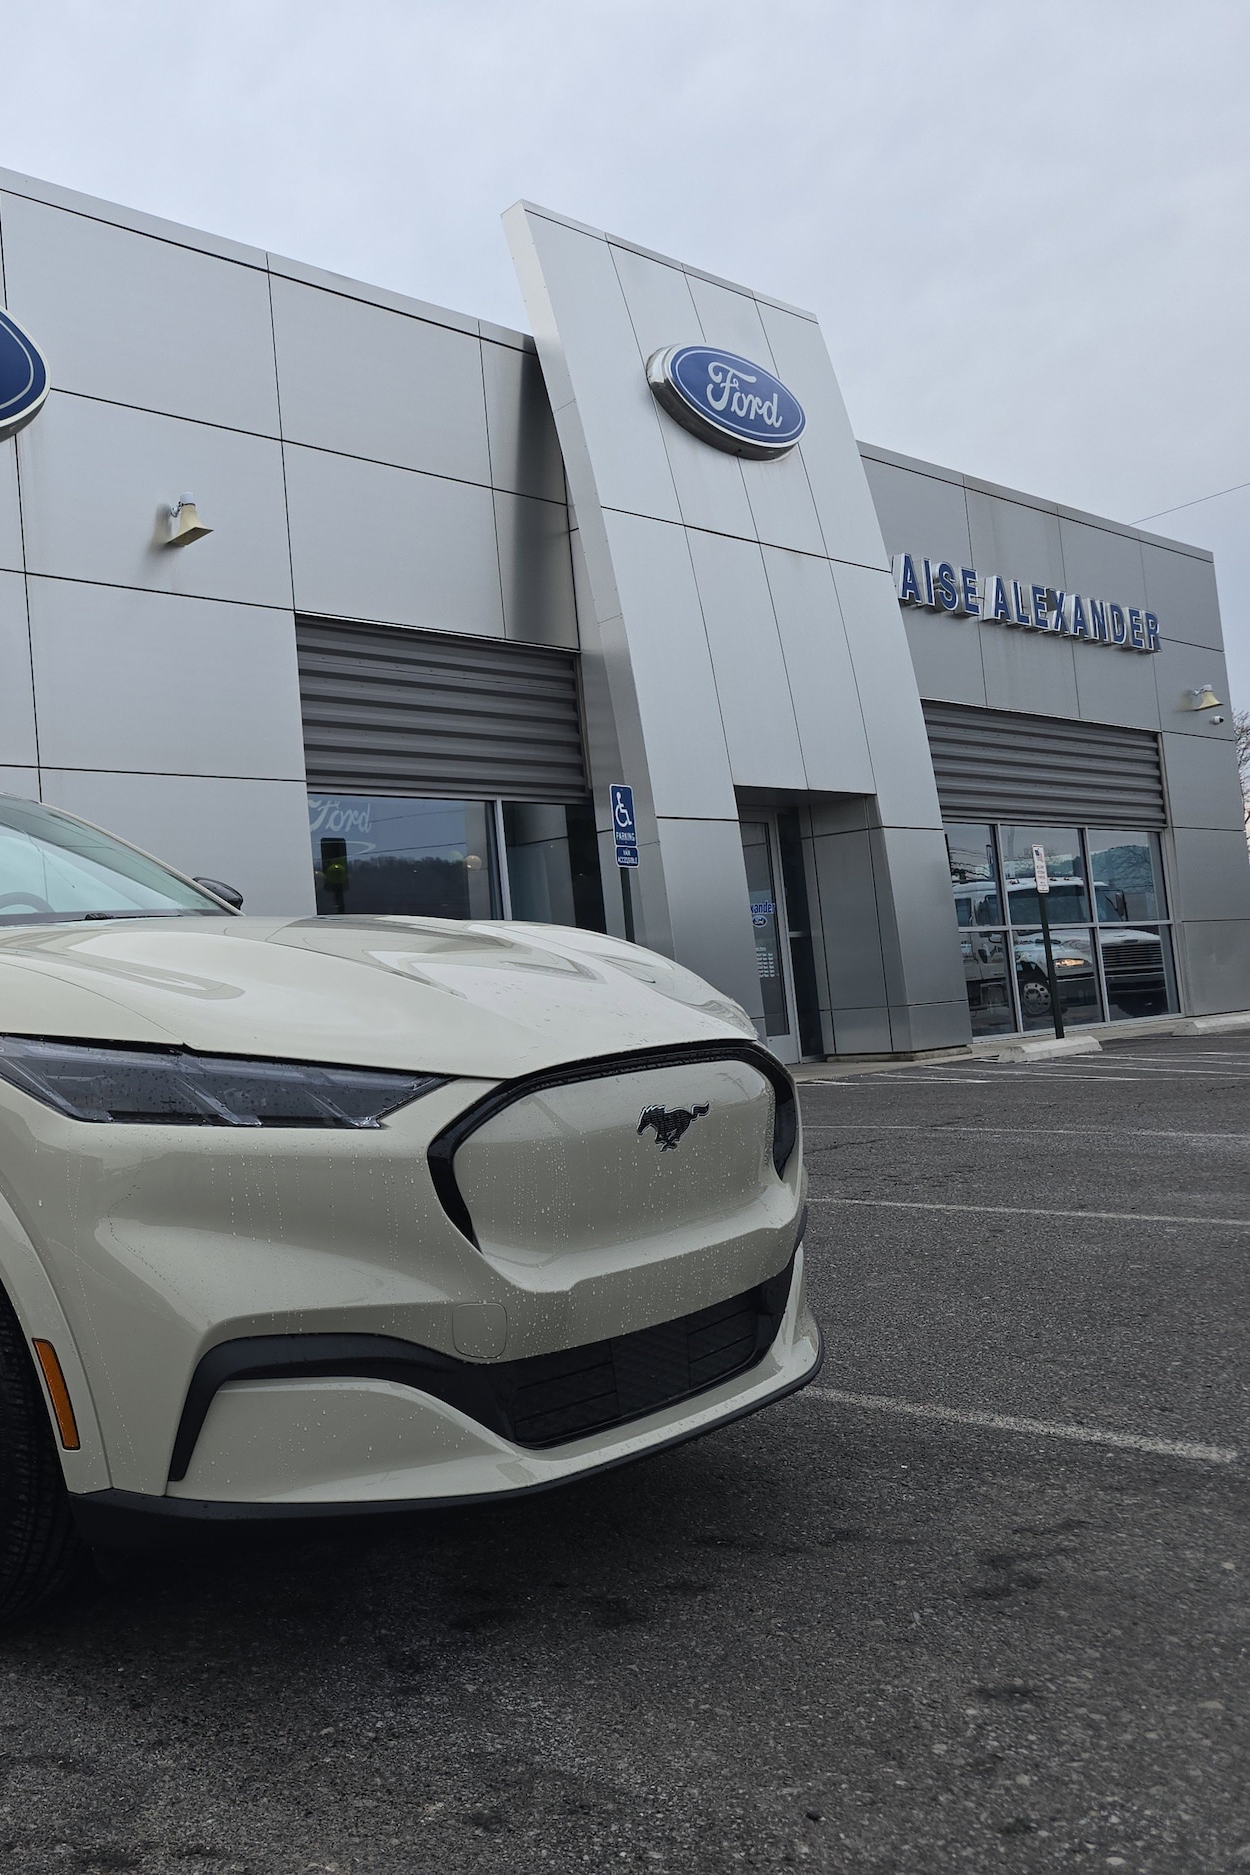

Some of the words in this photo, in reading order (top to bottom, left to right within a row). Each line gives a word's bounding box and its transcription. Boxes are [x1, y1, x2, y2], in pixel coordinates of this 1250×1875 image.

[706, 361, 783, 428] Ford
[988, 575, 1162, 652] ALEXANDER
[616, 831, 635, 841] PARKING
